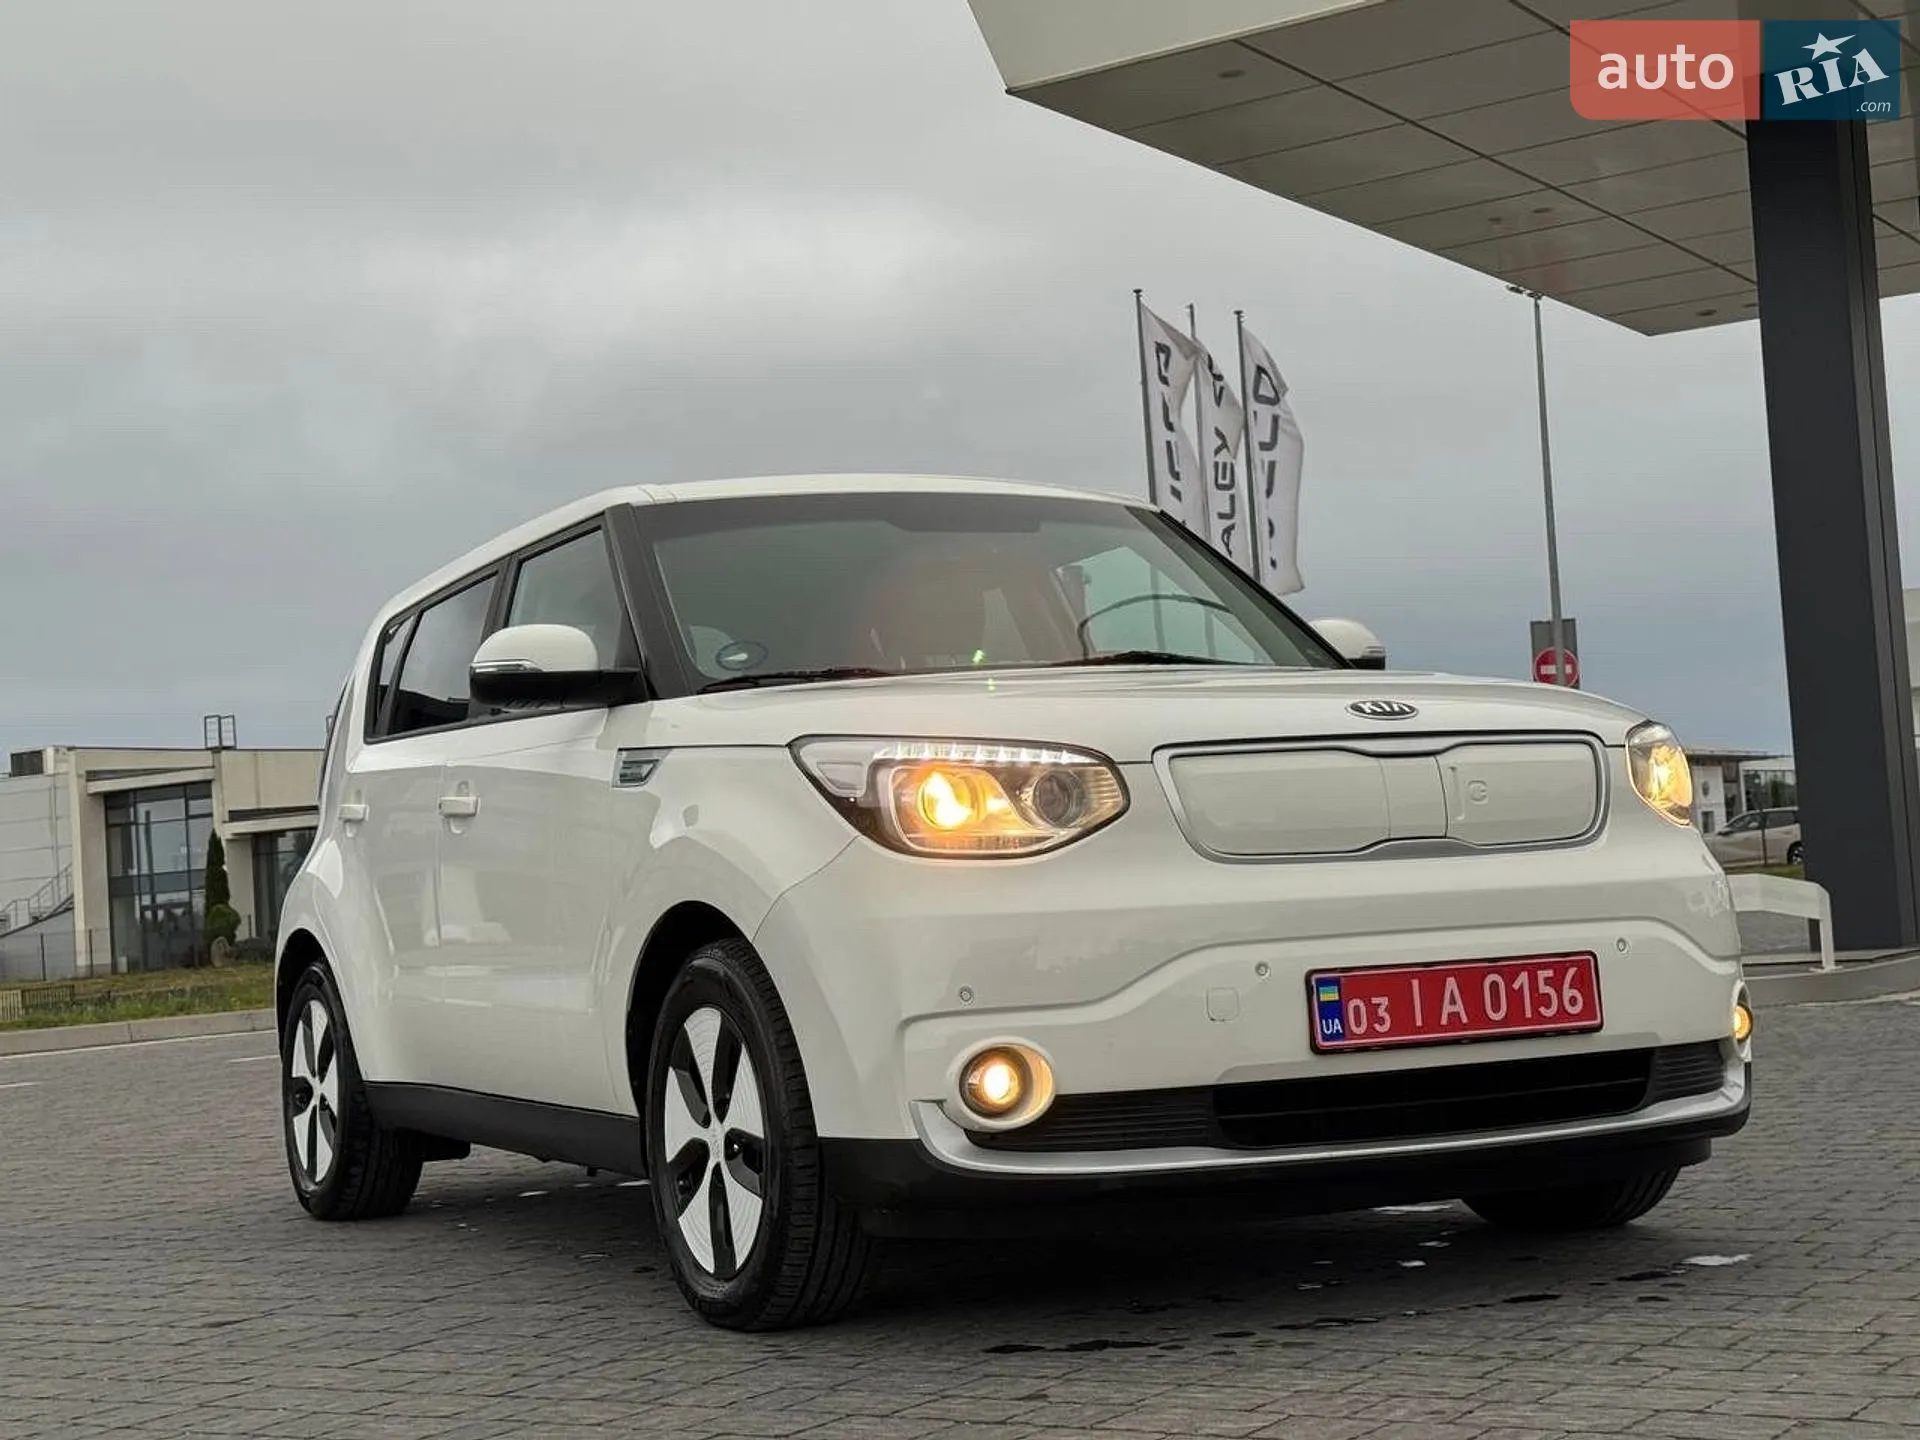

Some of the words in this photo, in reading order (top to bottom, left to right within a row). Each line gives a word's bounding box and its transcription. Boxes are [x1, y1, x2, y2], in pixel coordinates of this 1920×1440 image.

[1358, 701, 1410, 714] KIA
[1349, 998, 1391, 1034] 03
[1483, 967, 1584, 1022] 0156
[1324, 1019, 1343, 1034] UA
